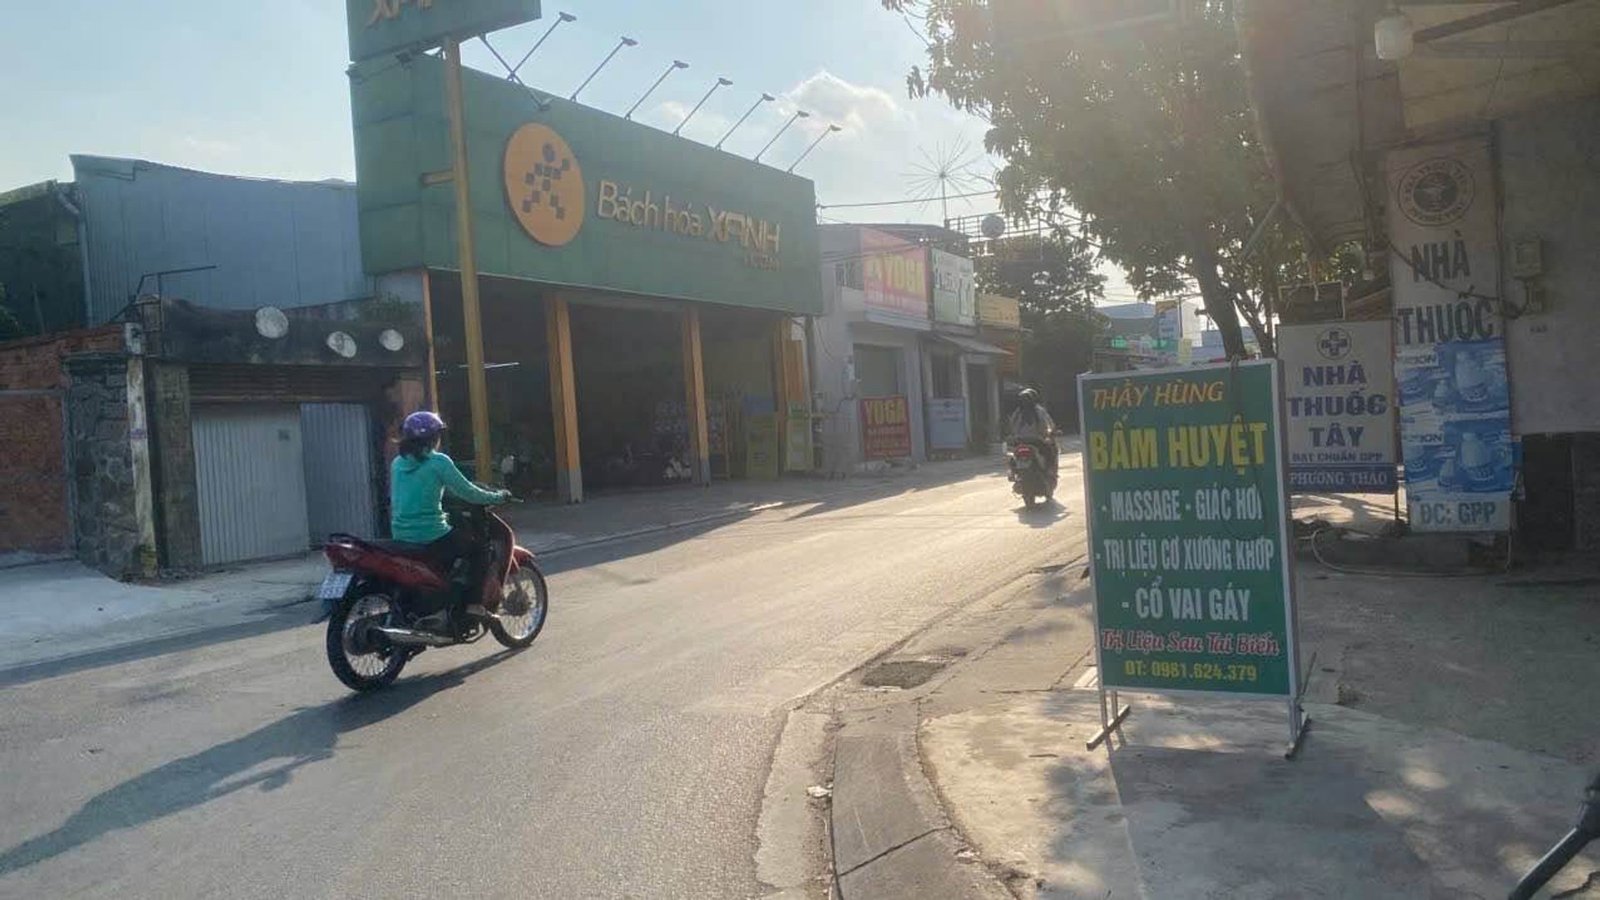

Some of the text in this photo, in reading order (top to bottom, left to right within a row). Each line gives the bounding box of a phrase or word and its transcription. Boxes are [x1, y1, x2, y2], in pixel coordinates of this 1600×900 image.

[598, 180, 780, 253] Bách hóa XANH
[1412, 231, 1470, 282] NHÀ
[1303, 360, 1367, 386] NHÀ
[1153, 378, 1225, 407] HÙNG
[1288, 388, 1387, 416] THUỐC
[1089, 411, 1268, 475] BẤM HUYỆT
[1309, 423, 1364, 447] TÂY
[1110, 482, 1263, 521] MASSAGE GIÁC HƠI
[1458, 501, 1496, 525] GPP
[1104, 532, 1274, 577] TRỊ LIỆU CƠ XƯƠNG KHỚP
[1135, 575, 1250, 621] CỔ VAI GÁY
[1102, 628, 1280, 656] Trị Liệu Sau Tai Biến
[1151, 660, 1257, 681] 0981.624.379
